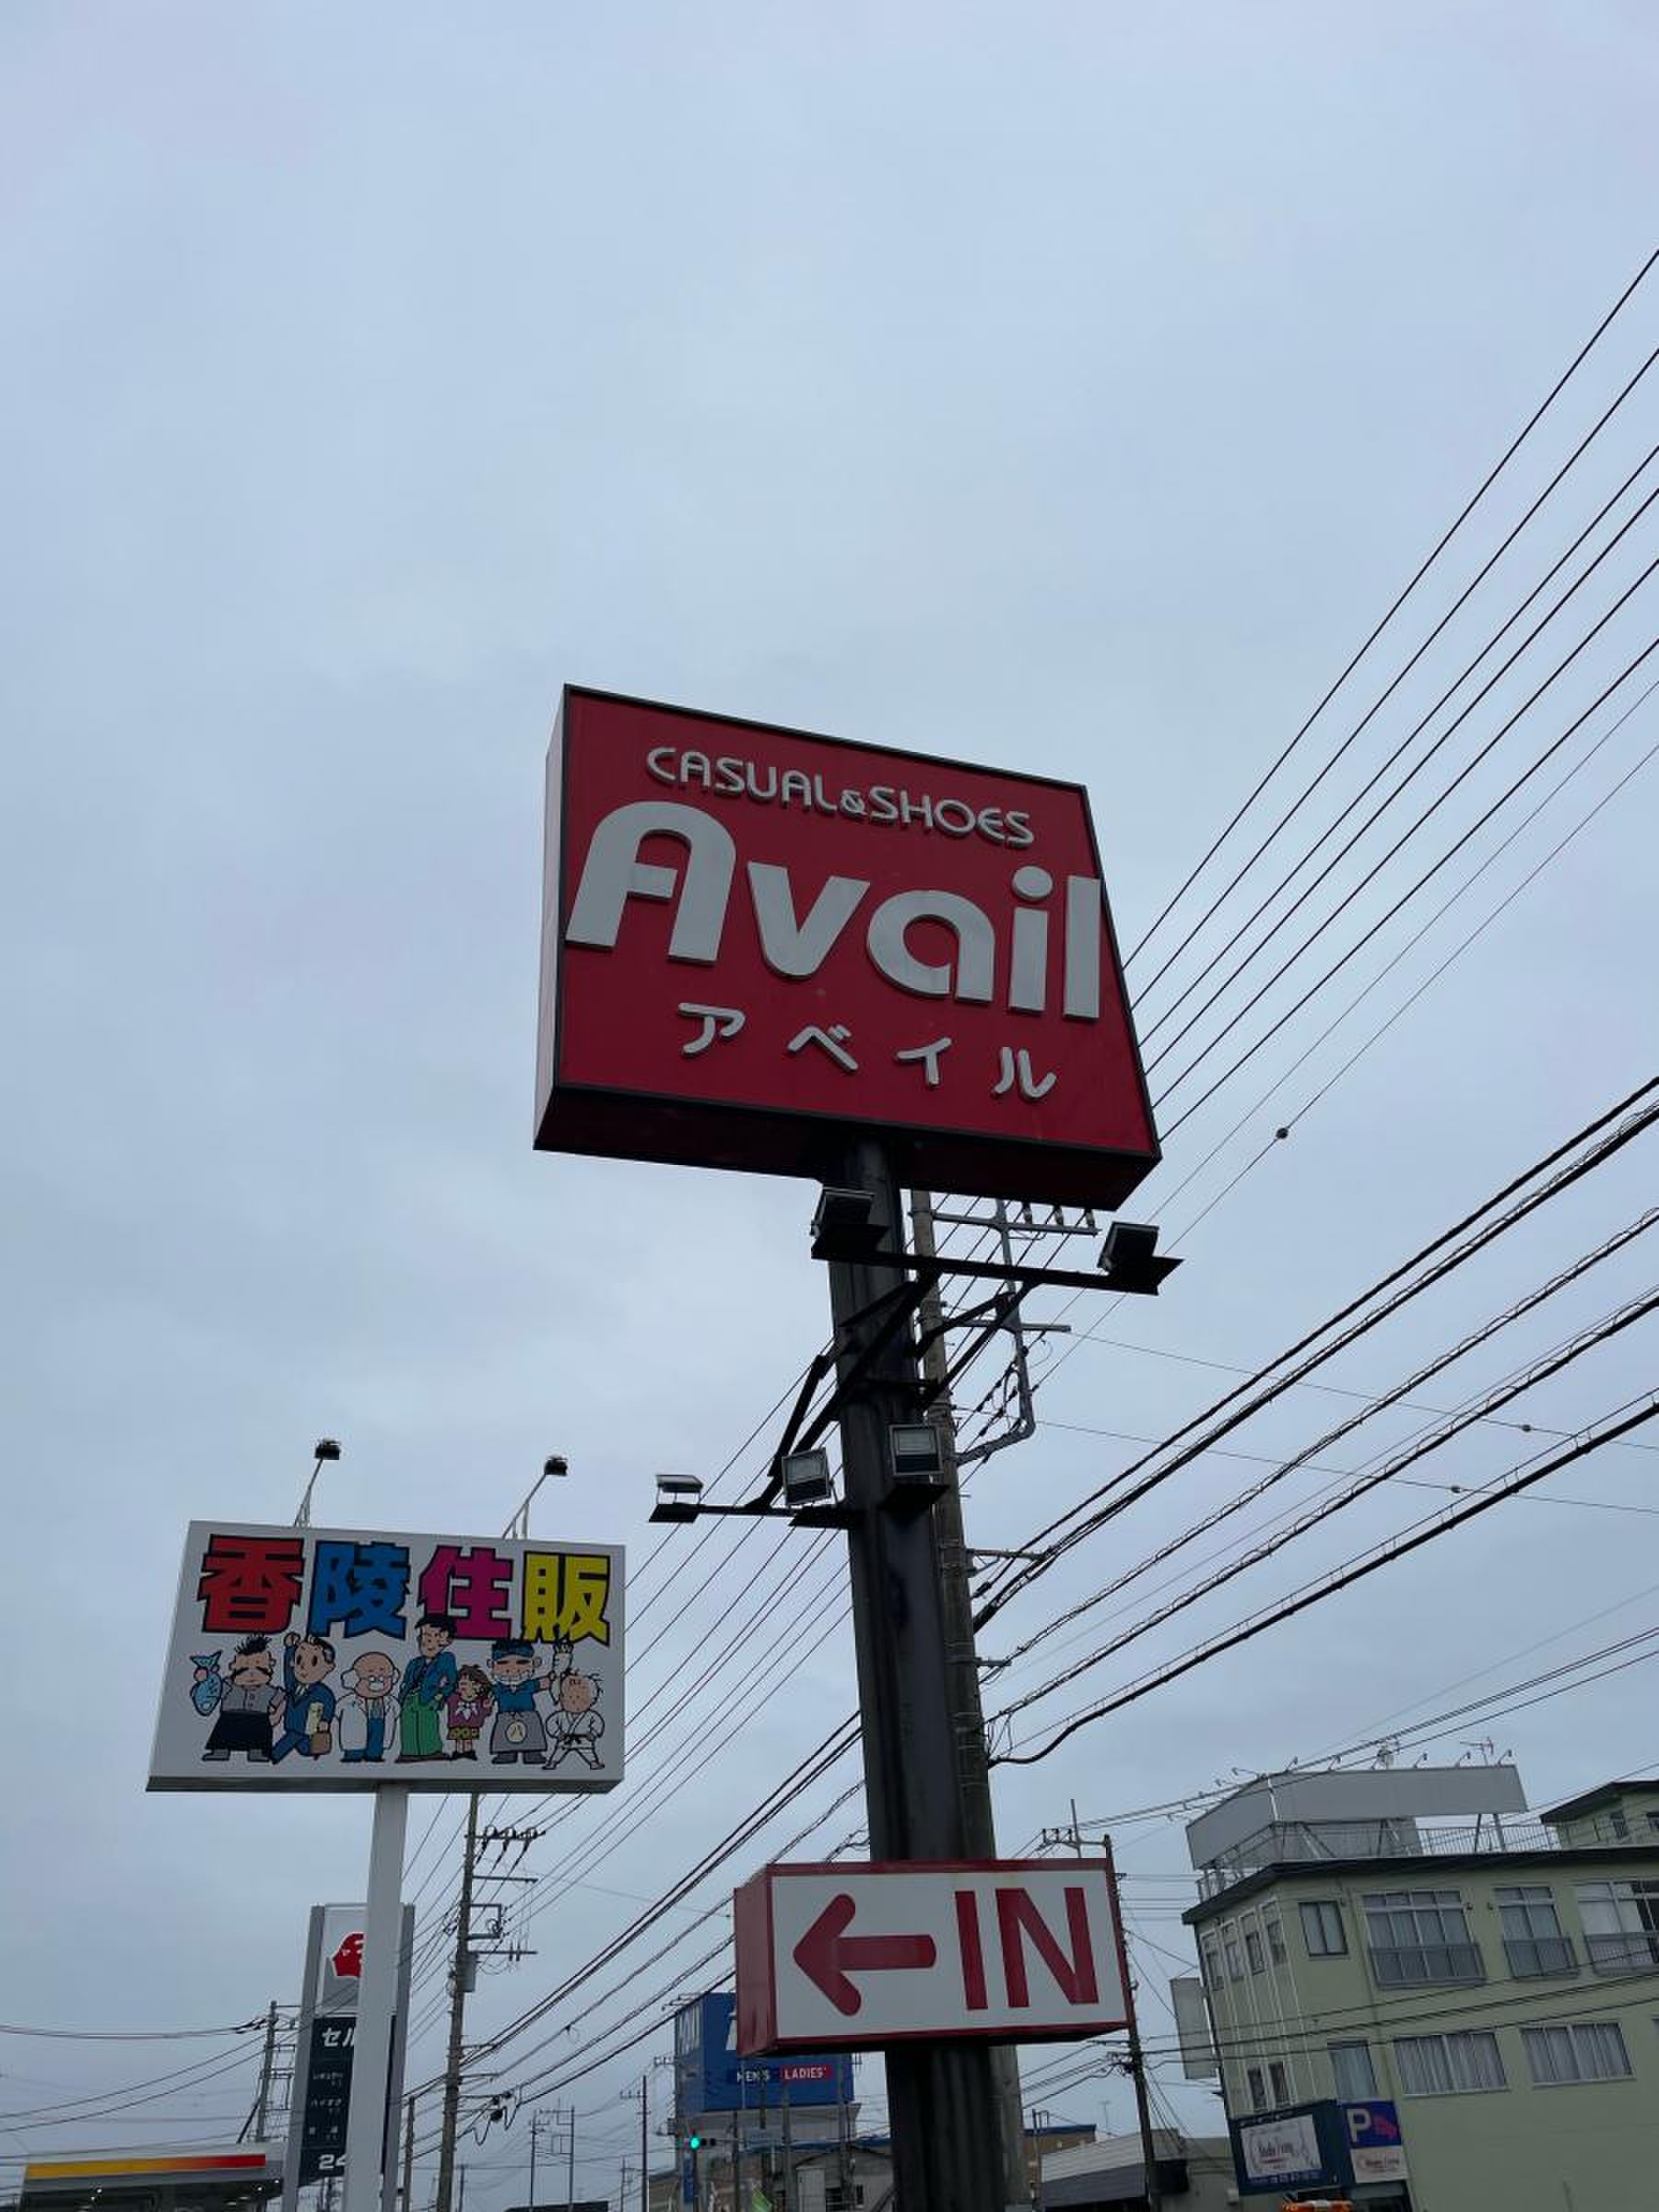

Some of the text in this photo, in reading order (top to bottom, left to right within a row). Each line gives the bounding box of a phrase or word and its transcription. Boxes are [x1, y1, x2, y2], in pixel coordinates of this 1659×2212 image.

[647, 745, 1035, 846] CASUAL&SHOES
[564, 800, 1101, 1019] Avail
[677, 1002, 1057, 1099] アベイル
[196, 1533, 612, 1647] 香陵住販
[954, 1887, 1100, 2011] IN
[1347, 2108, 1372, 2143] P
